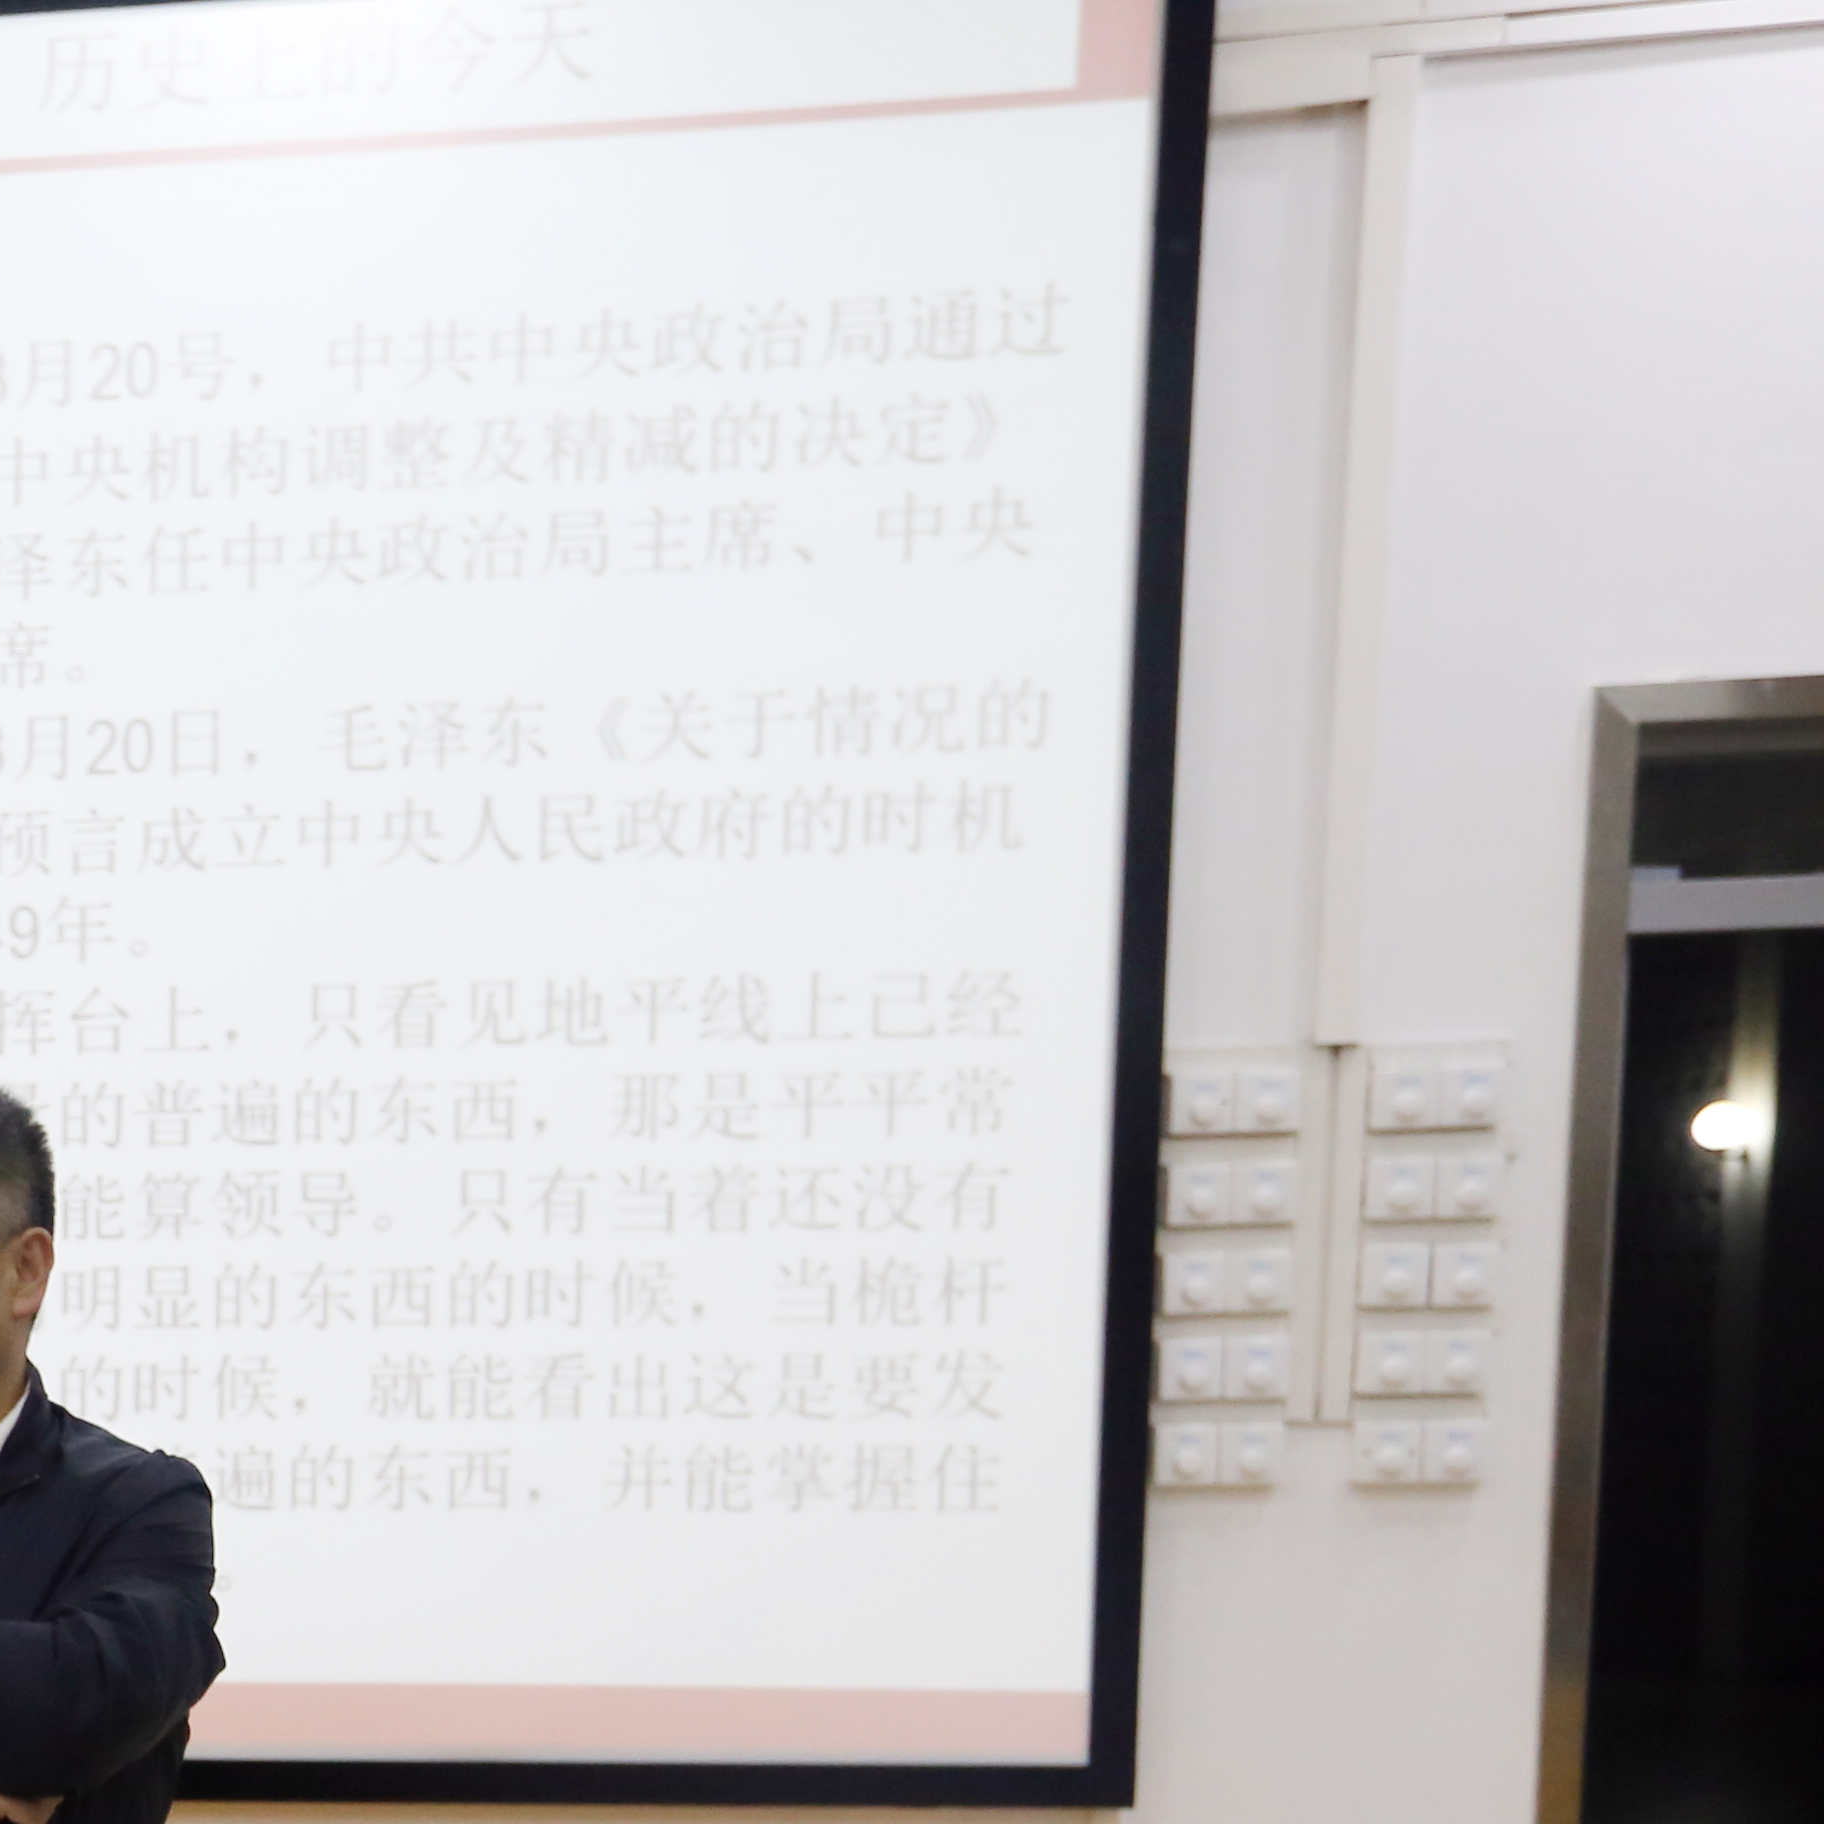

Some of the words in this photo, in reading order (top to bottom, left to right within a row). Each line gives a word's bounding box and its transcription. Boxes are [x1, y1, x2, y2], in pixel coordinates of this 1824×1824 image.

[36, 2, 598, 118] 历史上的今天
